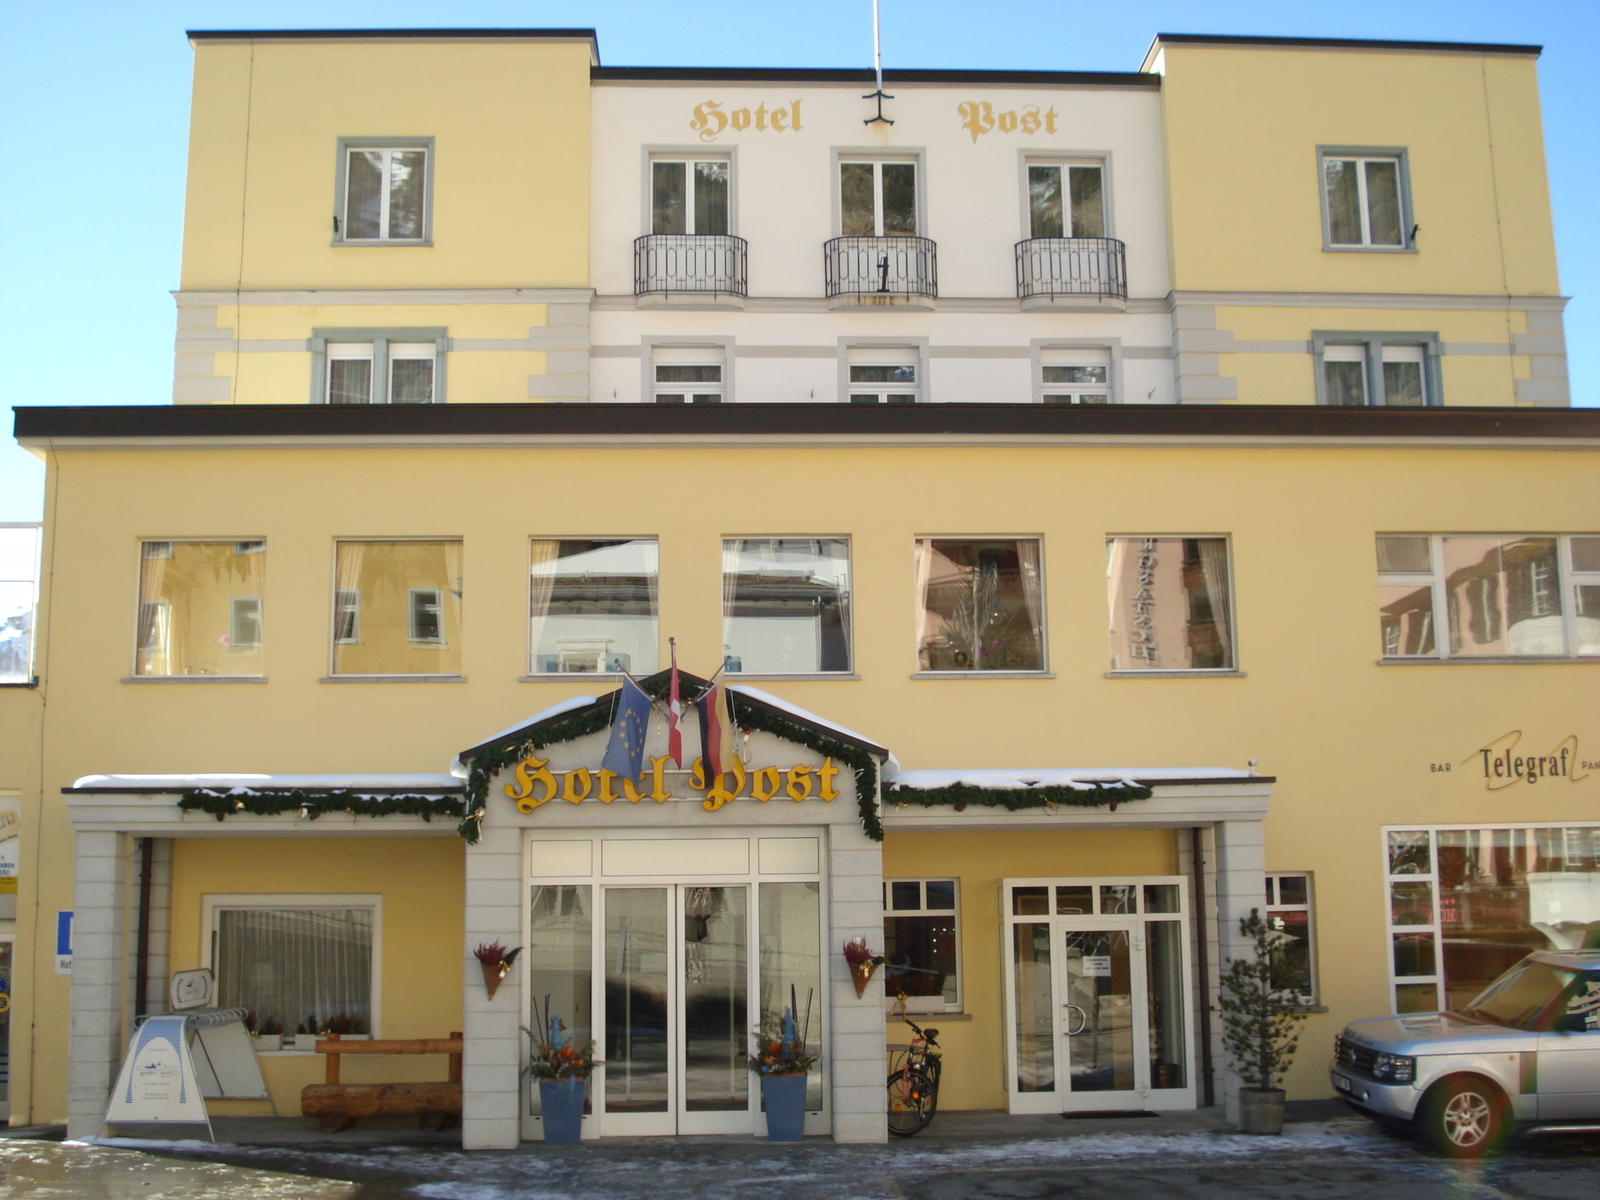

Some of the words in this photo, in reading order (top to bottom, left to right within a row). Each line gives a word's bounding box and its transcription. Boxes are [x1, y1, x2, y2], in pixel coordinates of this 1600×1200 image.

[689, 100, 804, 143] Hotel
[957, 100, 1059, 144] Post
[688, 755, 840, 812] Post
[1430, 763, 1452, 773] BAR
[1479, 747, 1569, 785] Telegraf
